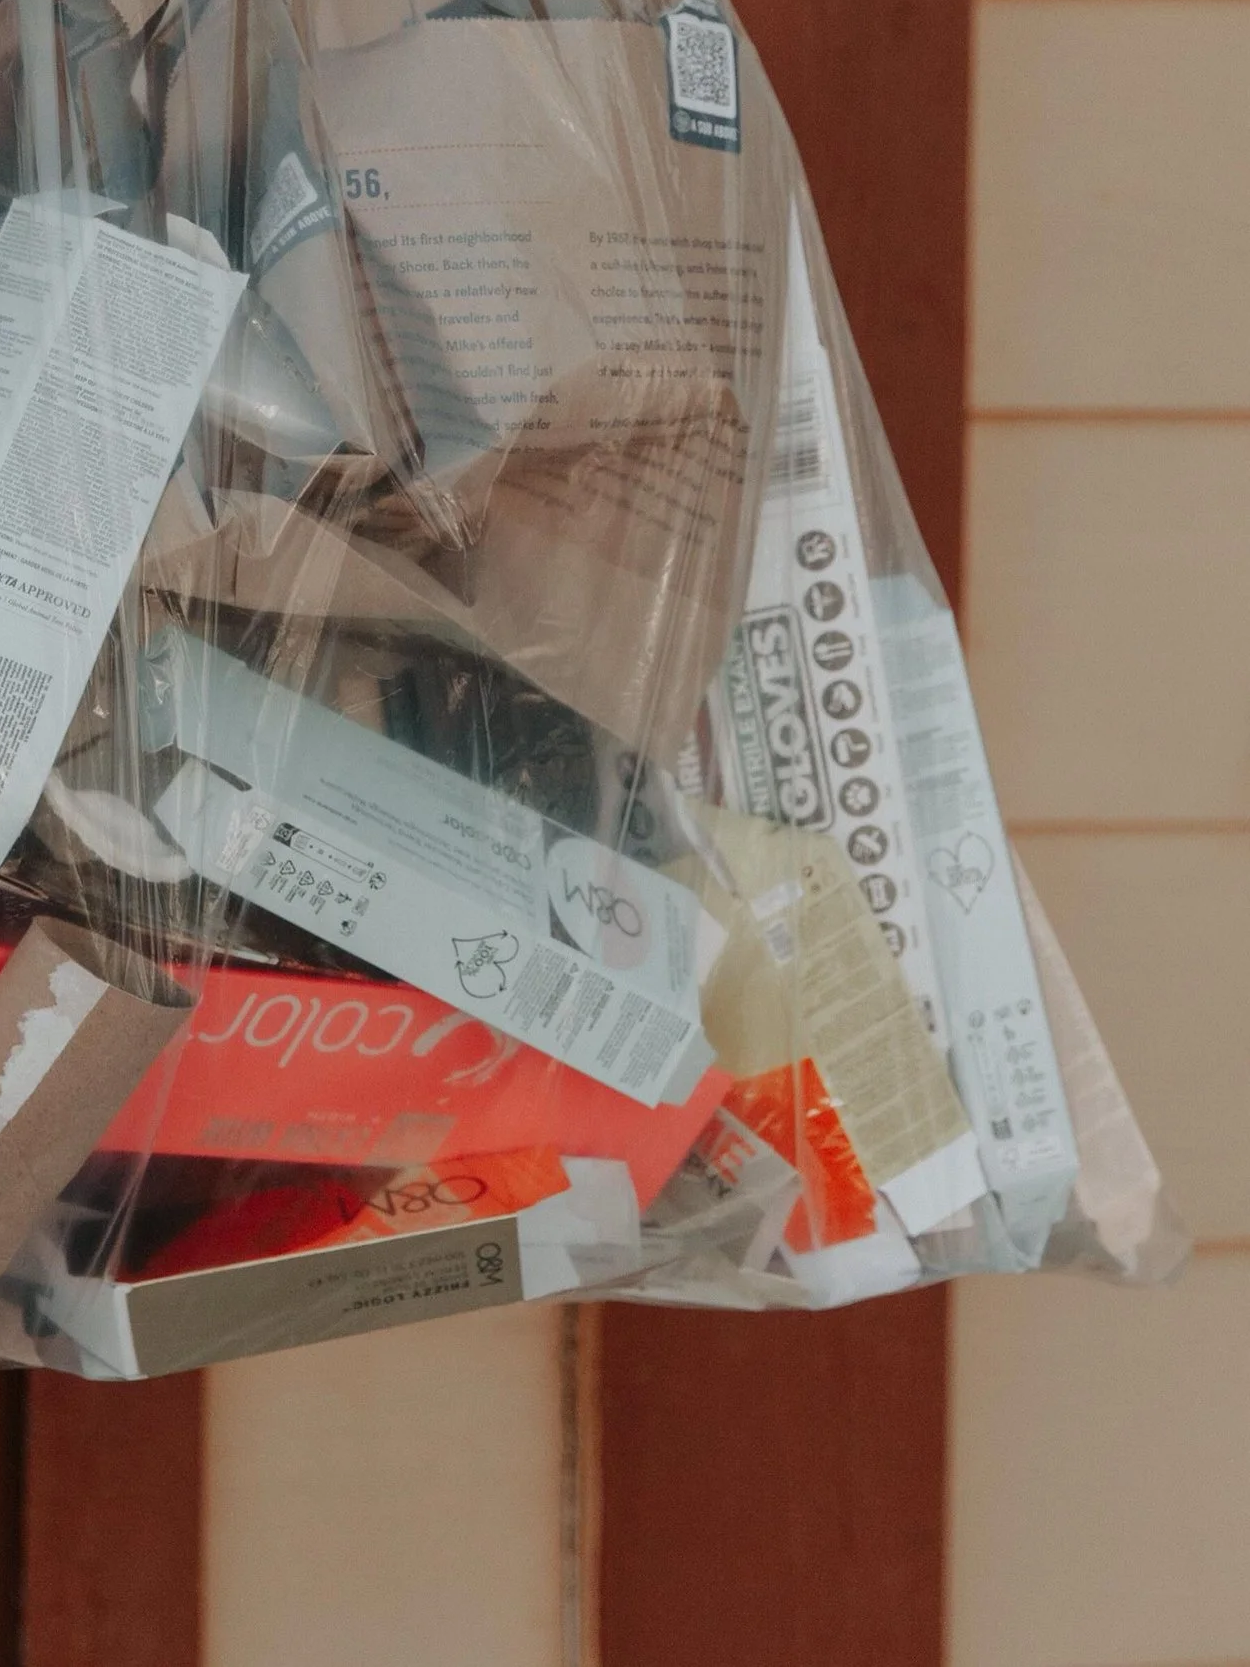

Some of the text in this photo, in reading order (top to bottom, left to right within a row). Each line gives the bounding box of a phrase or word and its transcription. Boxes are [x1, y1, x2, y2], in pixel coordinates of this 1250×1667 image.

[297, 205, 330, 231] ABOVE
[420, 233, 443, 245] first
[448, 231, 532, 248] neighborhood
[589, 231, 604, 247] By
[443, 258, 474, 271] Back
[477, 258, 510, 271] then,
[512, 257, 530, 269] the
[415, 287, 439, 299] was
[455, 284, 512, 299] relatively
[515, 285, 538, 296] new
[438, 310, 520, 325] travelers and
[446, 337, 533, 353] Mike's offered
[454, 364, 553, 380] couldn't find just
[501, 391, 527, 404] with
[536, 418, 551, 430] for
[4, 594, 27, 611] Global
[17, 580, 92, 619] APPROVED
[748, 622, 818, 817] GLOVES
[736, 718, 771, 813] NITRILE
[196, 984, 414, 1069] color
[337, 1170, 493, 1227] O&M
[474, 1240, 505, 1288] O&M
[412, 1280, 470, 1300] FRIZZY
